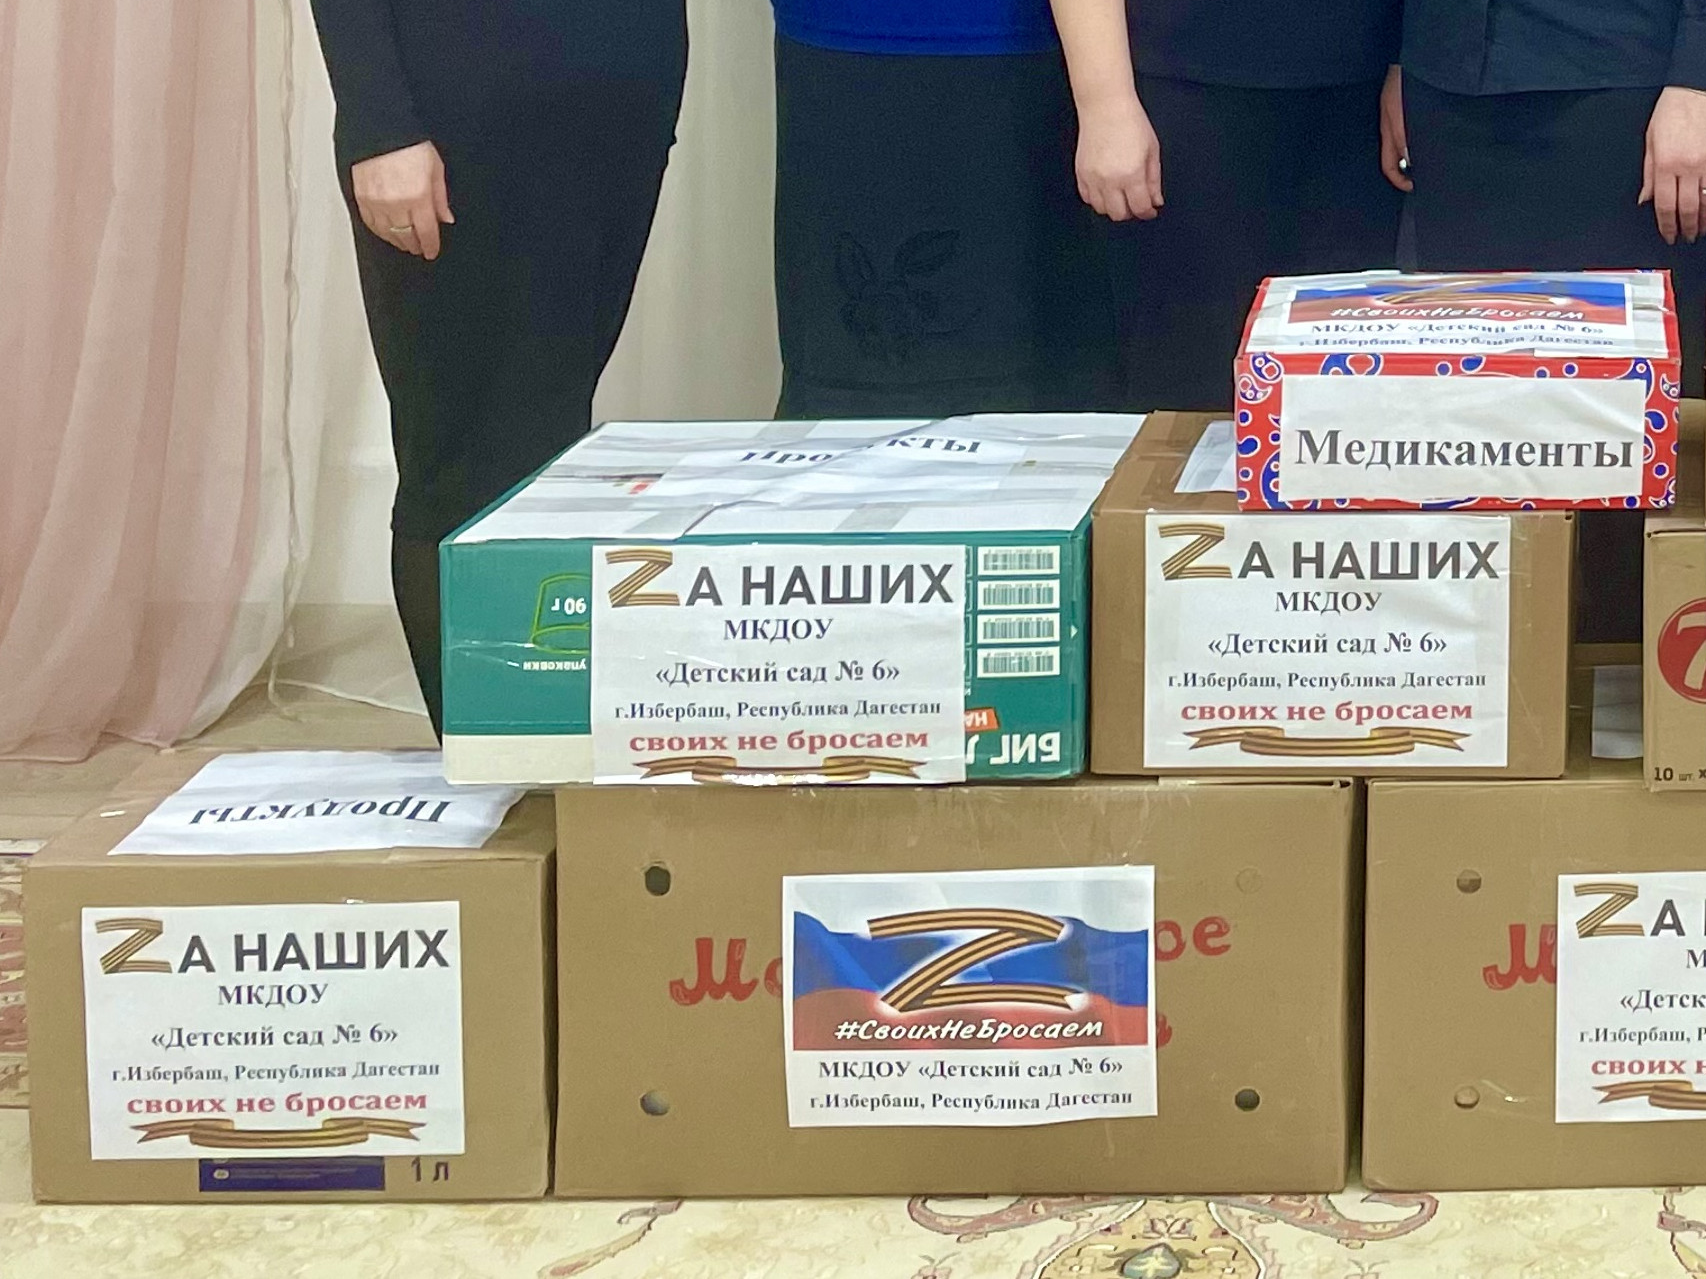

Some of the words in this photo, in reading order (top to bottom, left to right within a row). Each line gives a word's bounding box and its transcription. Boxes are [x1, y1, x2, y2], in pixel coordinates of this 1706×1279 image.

[740, 435, 980, 464] Прокты
[1295, 430, 1633, 470] Медикаменты
[1293, 541, 1499, 580] НАШИХ
[742, 564, 953, 605] НАШИХ
[564, 598, 587, 615] 90
[1276, 592, 1382, 615] МКДОУ
[724, 619, 833, 643] МКДОУ
[1209, 634, 1327, 657] «Детский
[1337, 639, 1376, 655] сад
[1384, 632, 1411, 652] №
[1420, 633, 1446, 652] 6»
[523, 658, 587, 671] упаковки
[656, 662, 777, 686] «Детский
[787, 667, 827, 683] сад
[835, 661, 863, 681] №
[872, 660, 899, 680] 6»
[1288, 673, 1395, 691] Республика
[1401, 672, 1485, 689] Дагестан
[738, 701, 848, 720] Республика
[854, 700, 940, 717] Дагестан
[1181, 704, 1278, 721] своих
[1287, 705, 1325, 720] не
[1334, 701, 1473, 725] бросаем
[629, 734, 728, 752] своих
[738, 734, 777, 750] не
[787, 730, 929, 756] бросаем
[990, 732, 1060, 765] БИГ
[1654, 767, 1673, 781] 10
[190, 792, 459, 824] Продукты
[234, 929, 449, 972] НАШИХ
[219, 984, 328, 1008] МКДОУ
[152, 1026, 273, 1050] «Детский
[284, 1031, 324, 1046] сад
[332, 1024, 360, 1044] №
[370, 1024, 397, 1042] 6»
[834, 1019, 1103, 1044] #СвоихНеБросаем
[235, 1064, 346, 1083] Республика
[352, 1062, 439, 1078] Дагестан
[820, 1062, 910, 1080] МКДОУ
[919, 1061, 1019, 1079] «Детский
[1028, 1065, 1061, 1077] сад
[1069, 1058, 1092, 1074] №
[1100, 1058, 1122, 1073] 6»
[1591, 1058, 1687, 1076] своих
[127, 1097, 226, 1114] своих
[235, 1097, 276, 1112] не
[285, 1092, 428, 1117] бросаем
[932, 1094, 1039, 1112] Республика
[1046, 1093, 1131, 1110] Дагестан
[411, 1157, 421, 1182] 1
